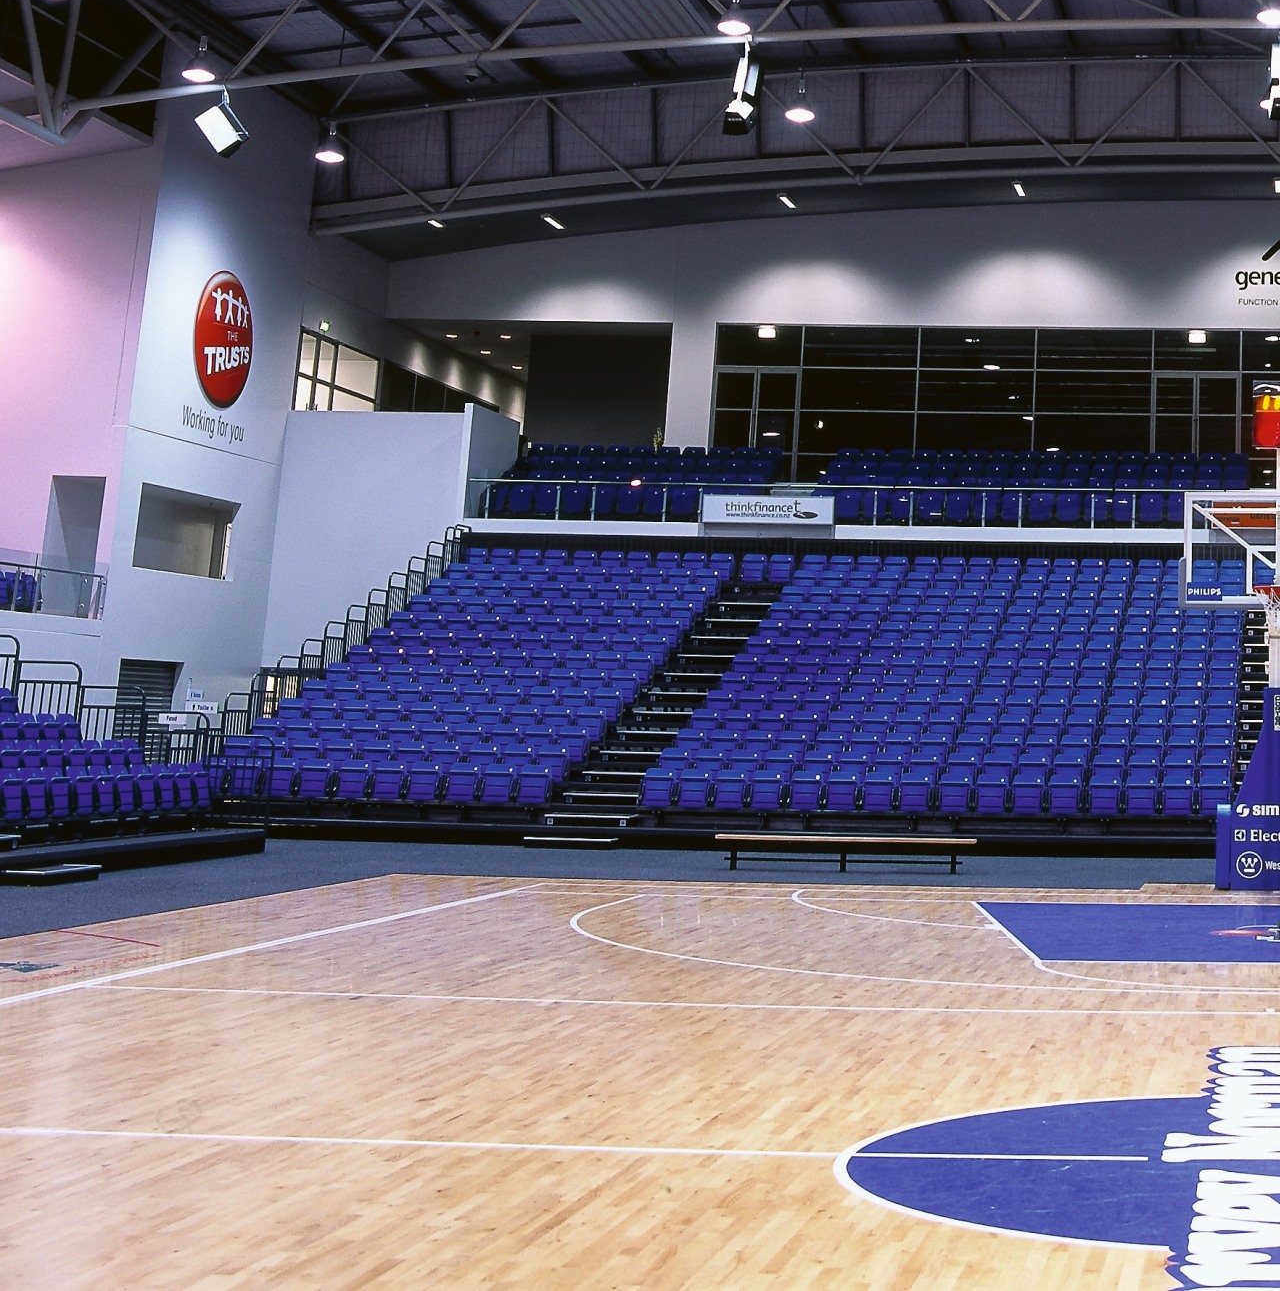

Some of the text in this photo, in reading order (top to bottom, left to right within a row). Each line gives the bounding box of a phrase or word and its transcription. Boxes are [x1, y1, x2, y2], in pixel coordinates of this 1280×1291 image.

[1238, 298, 1279, 306] FUNCTION
[227, 331, 239, 342] THE
[203, 346, 250, 376] TRUSTS
[182, 405, 245, 444] Working for you
[725, 501, 793, 513] thinkfinance
[1187, 587, 1222, 596] PHILIPS
